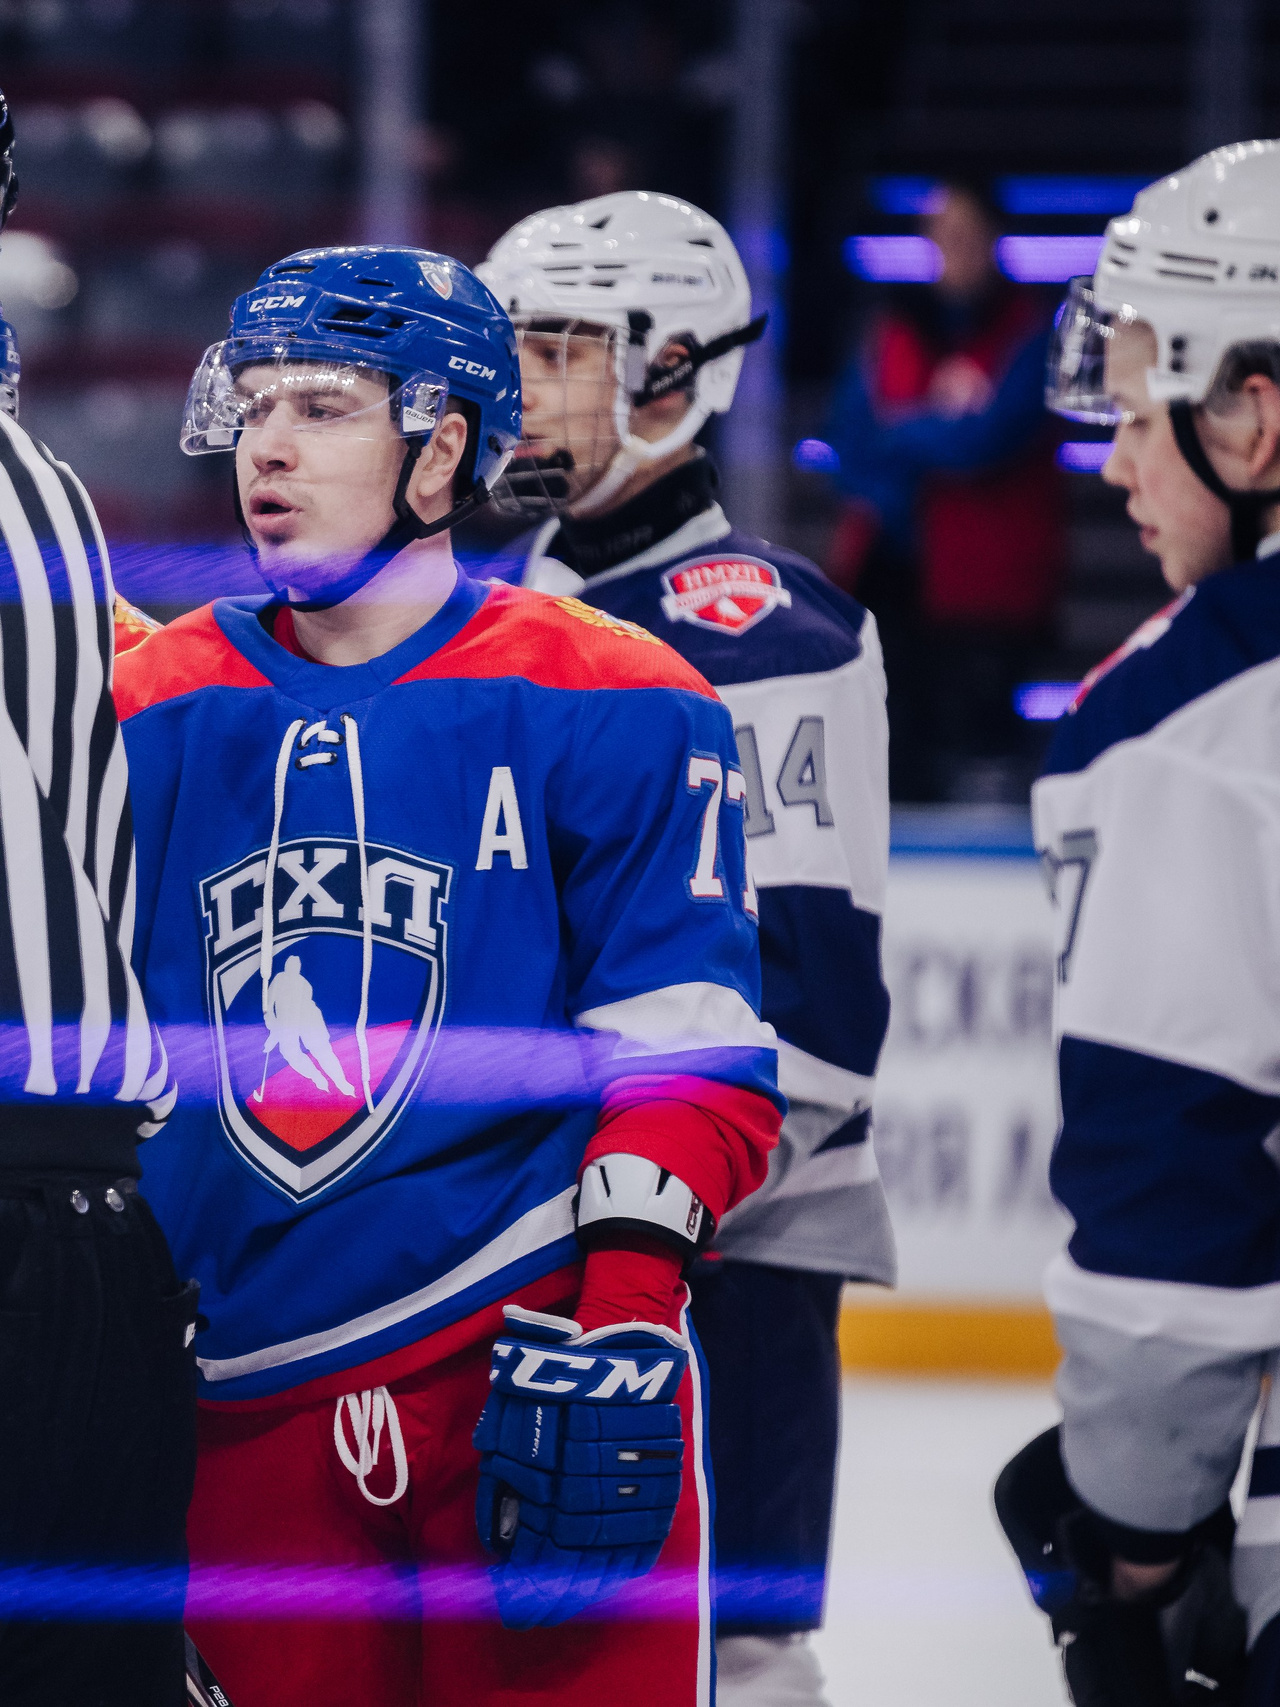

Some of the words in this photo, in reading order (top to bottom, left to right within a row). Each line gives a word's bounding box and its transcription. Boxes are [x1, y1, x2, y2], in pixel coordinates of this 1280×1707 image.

[248, 295, 307, 313] CCM
[448, 355, 497, 381] CCM
[404, 409, 435, 425] BAUER
[734, 715, 836, 839] 14
[475, 766, 528, 870] A
[209, 1685, 229, 1707] P28
